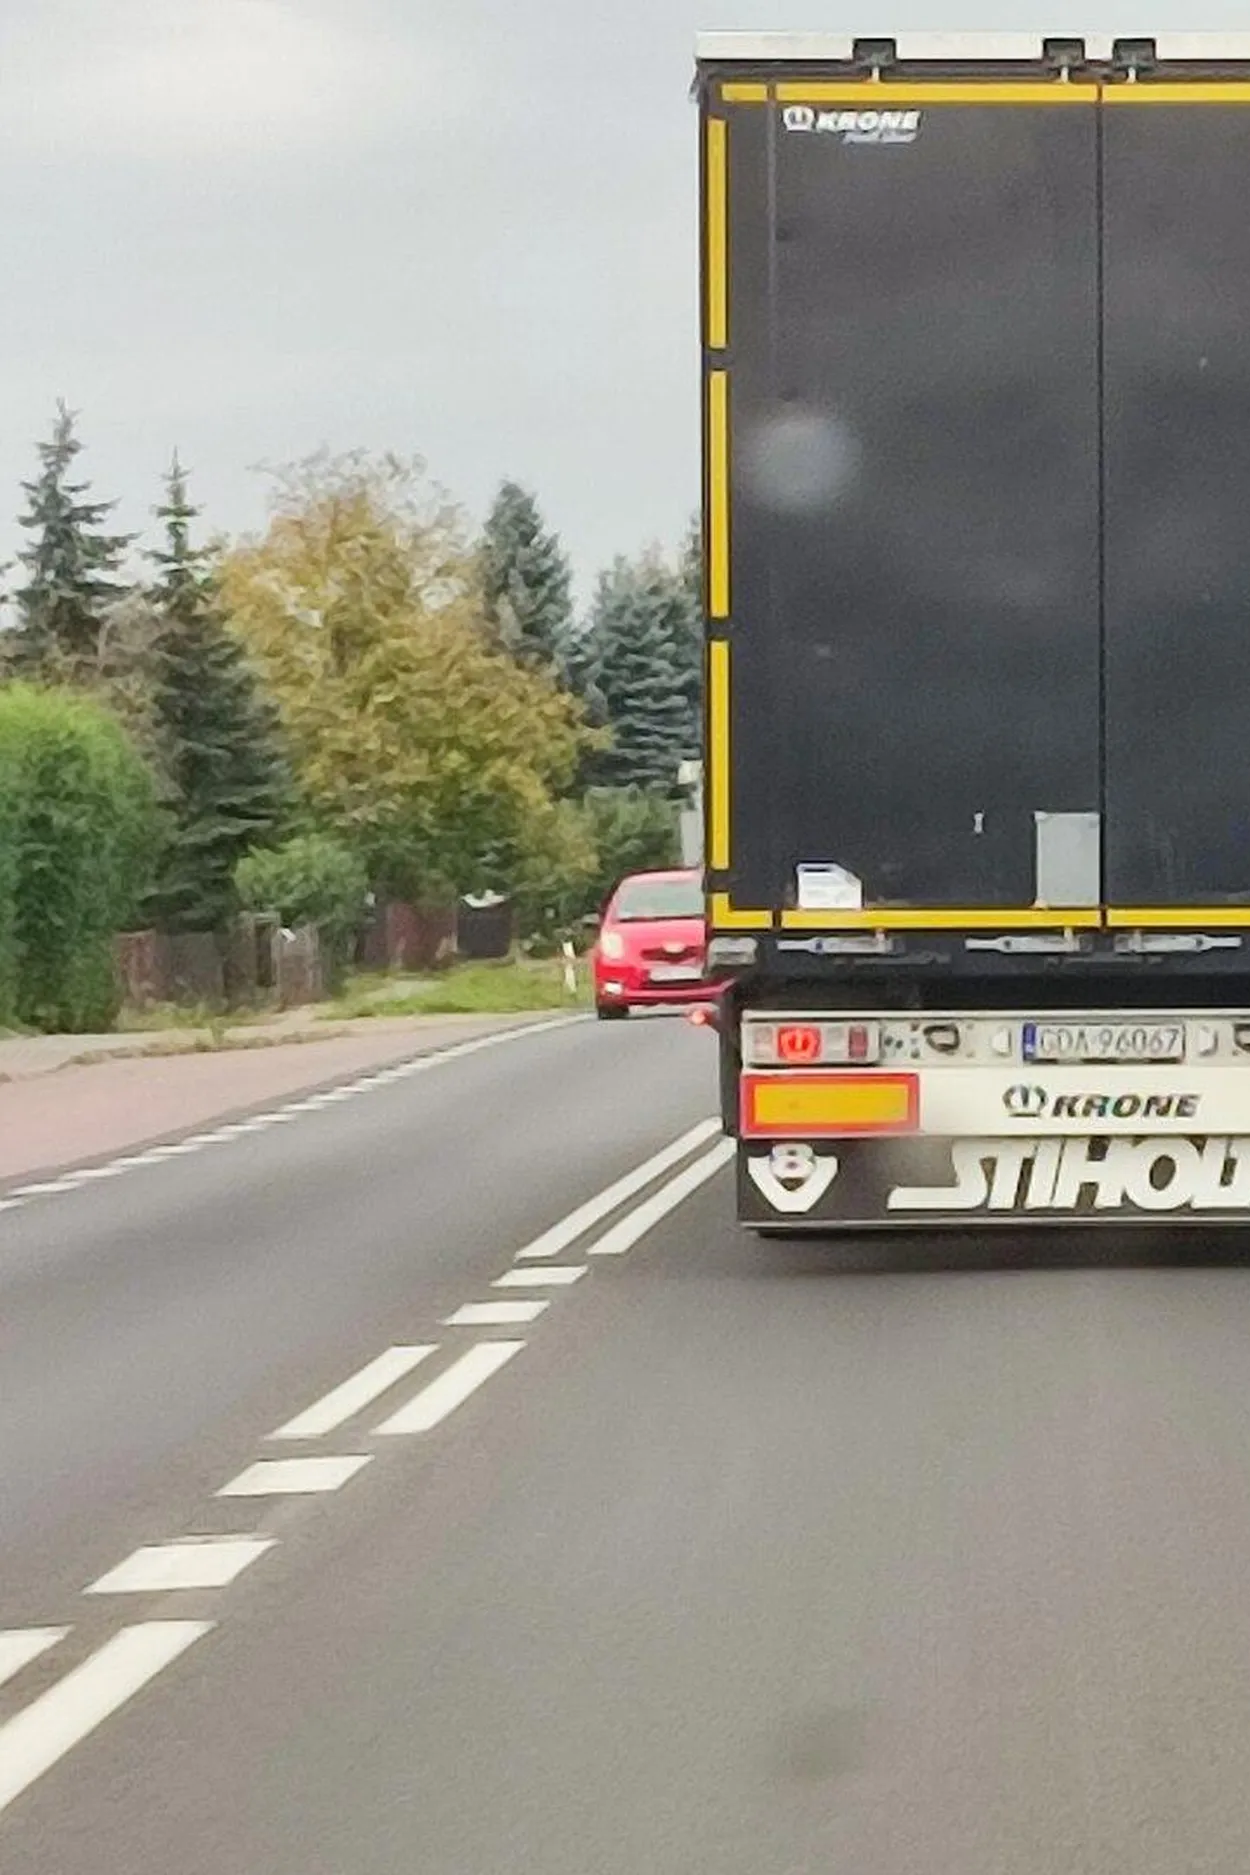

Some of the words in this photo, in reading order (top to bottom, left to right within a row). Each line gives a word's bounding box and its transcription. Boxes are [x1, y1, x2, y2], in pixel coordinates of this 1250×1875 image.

[817, 110, 921, 131] KRONE
[1099, 1028, 1179, 1053] 96067
[1052, 1093, 1199, 1117] KRONE
